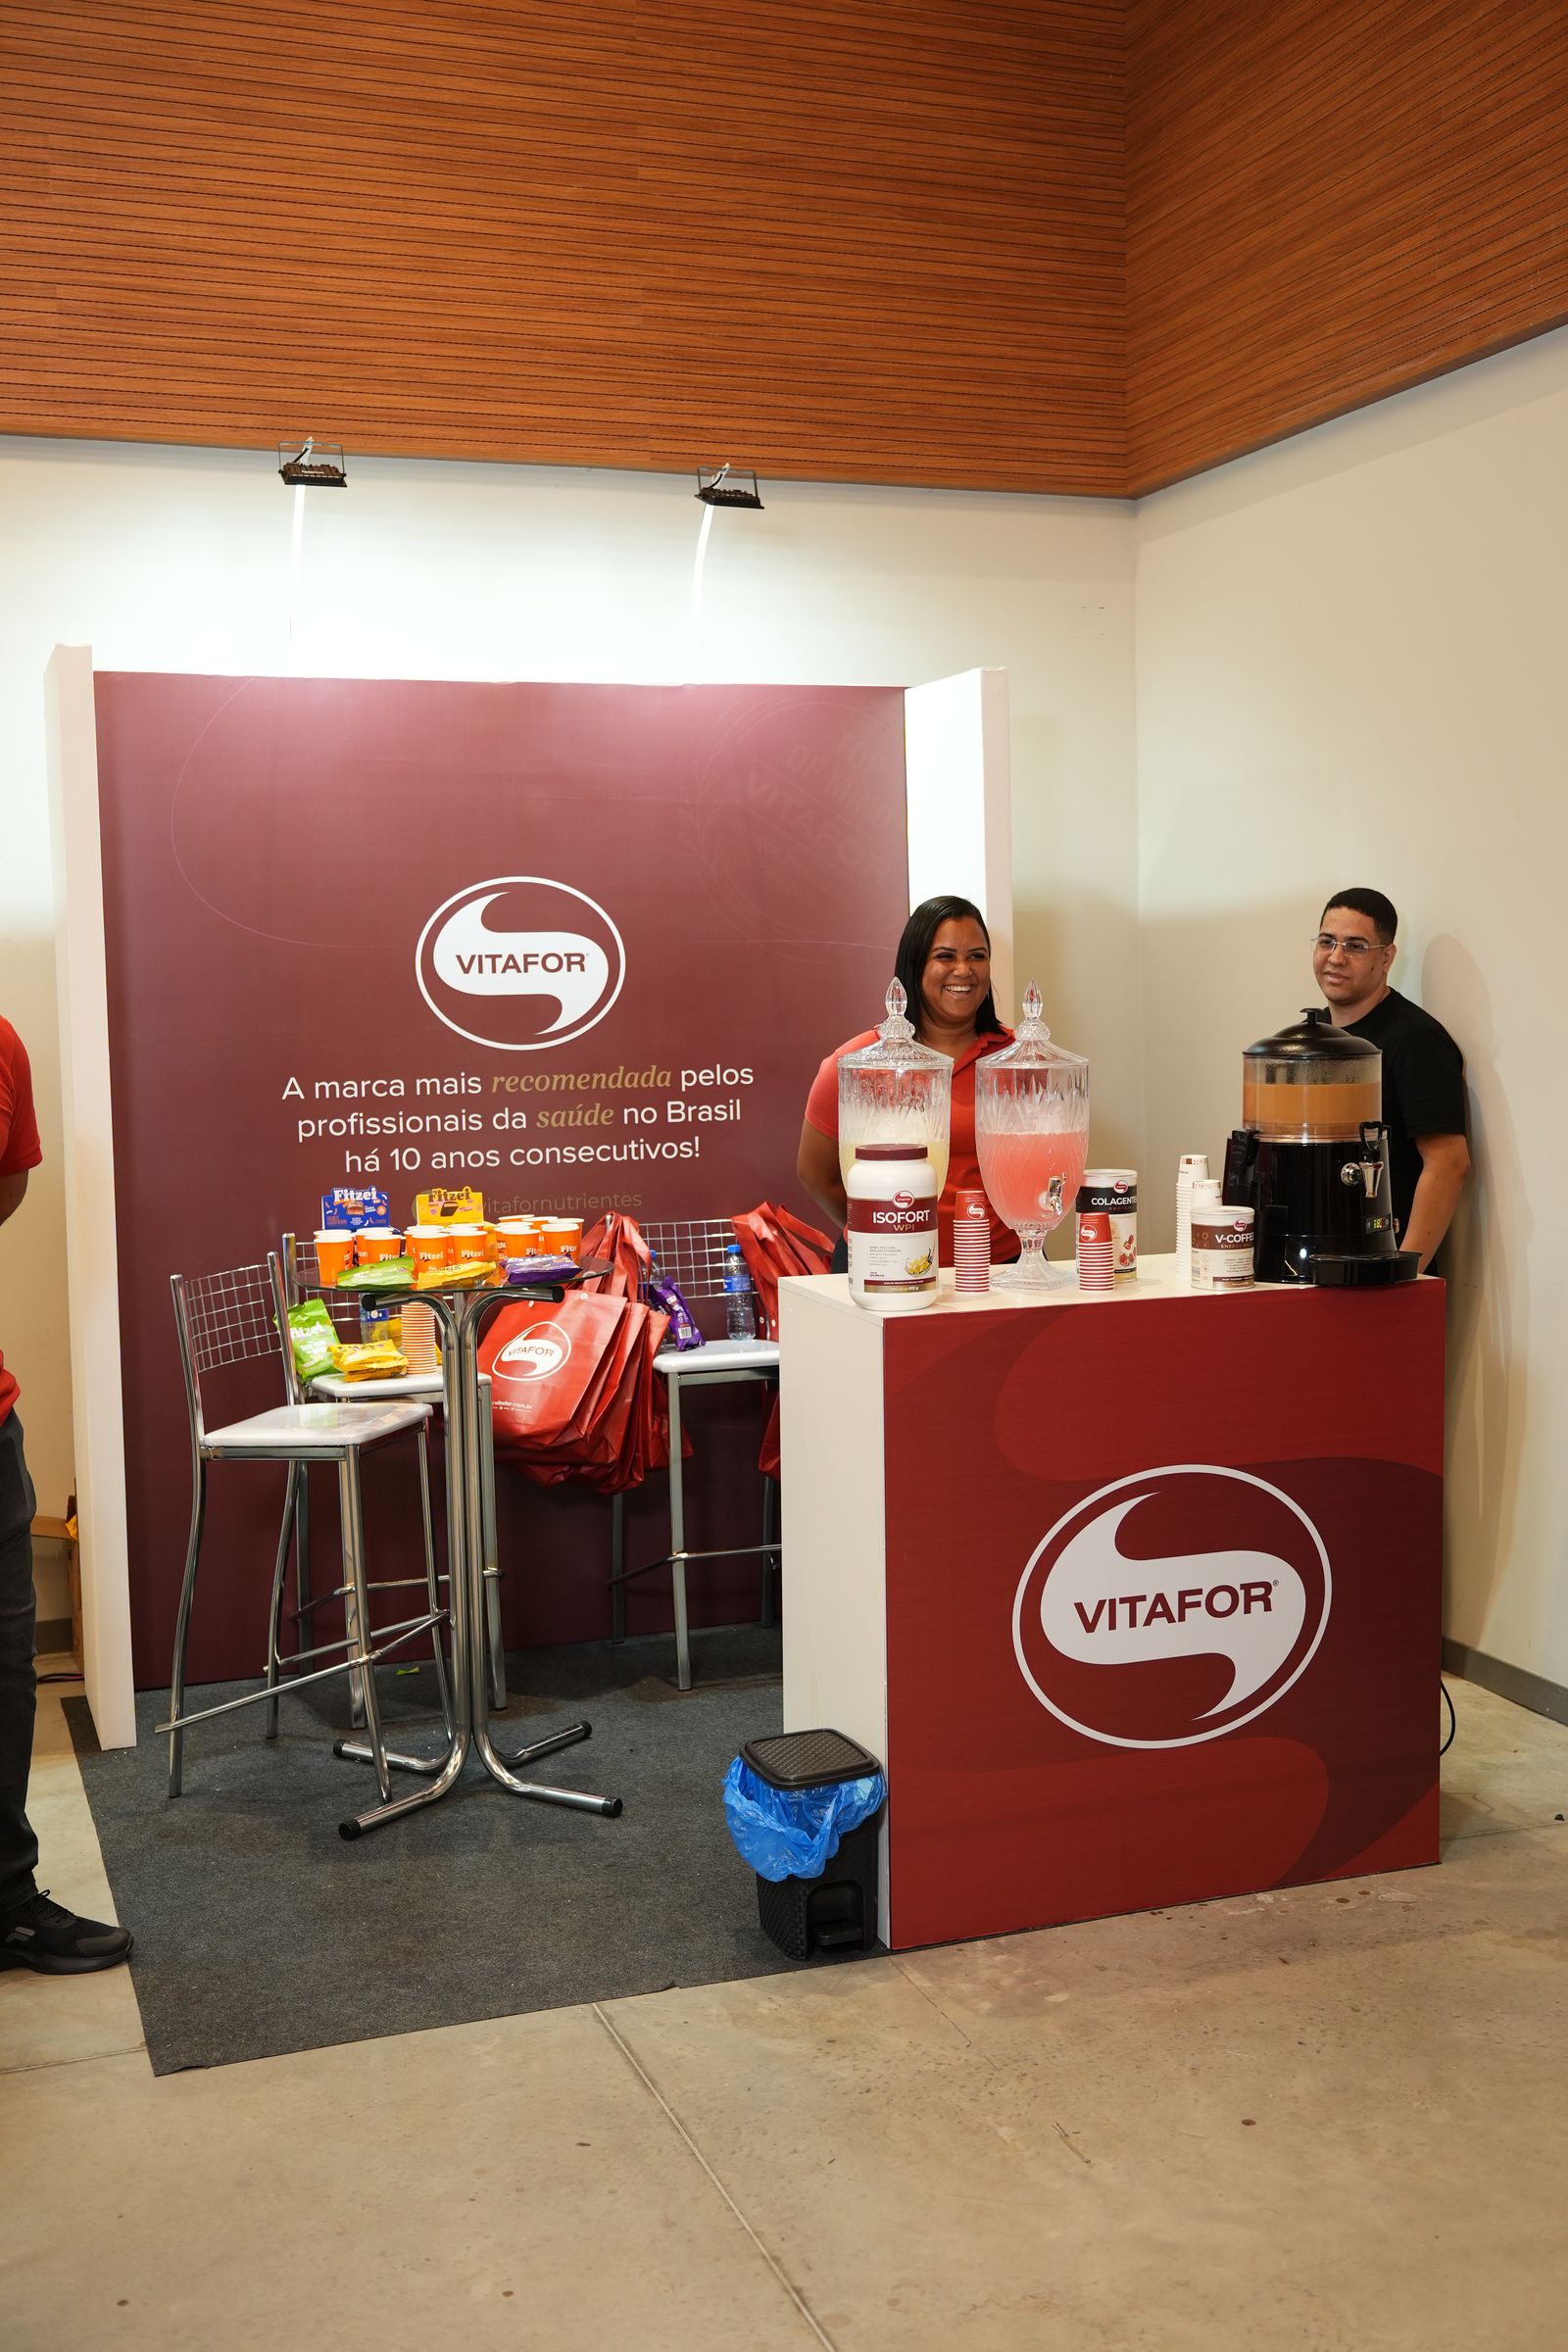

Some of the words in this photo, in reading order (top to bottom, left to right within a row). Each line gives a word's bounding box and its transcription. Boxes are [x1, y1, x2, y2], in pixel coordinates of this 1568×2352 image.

[456, 953, 585, 974] VITAFOR
[282, 1077, 305, 1100] A
[315, 1079, 405, 1099] marca
[416, 1072, 481, 1096] mais
[492, 1065, 671, 1093] recomendada
[681, 1063, 754, 1092] pelos
[298, 1108, 483, 1143] profissionais
[492, 1107, 526, 1129] da
[536, 1103, 613, 1127] saúde
[624, 1106, 657, 1124] no
[667, 1099, 741, 1122] Brasil
[346, 1148, 379, 1172] há
[390, 1148, 420, 1170] 10
[431, 1149, 500, 1169] anos
[510, 1136, 700, 1165] consecutivos!
[333, 1187, 377, 1201] Fitzei
[428, 1188, 470, 1202] Fitzei
[872, 1209, 930, 1224] ISOFORT
[508, 1345, 555, 1357] VITAFOR
